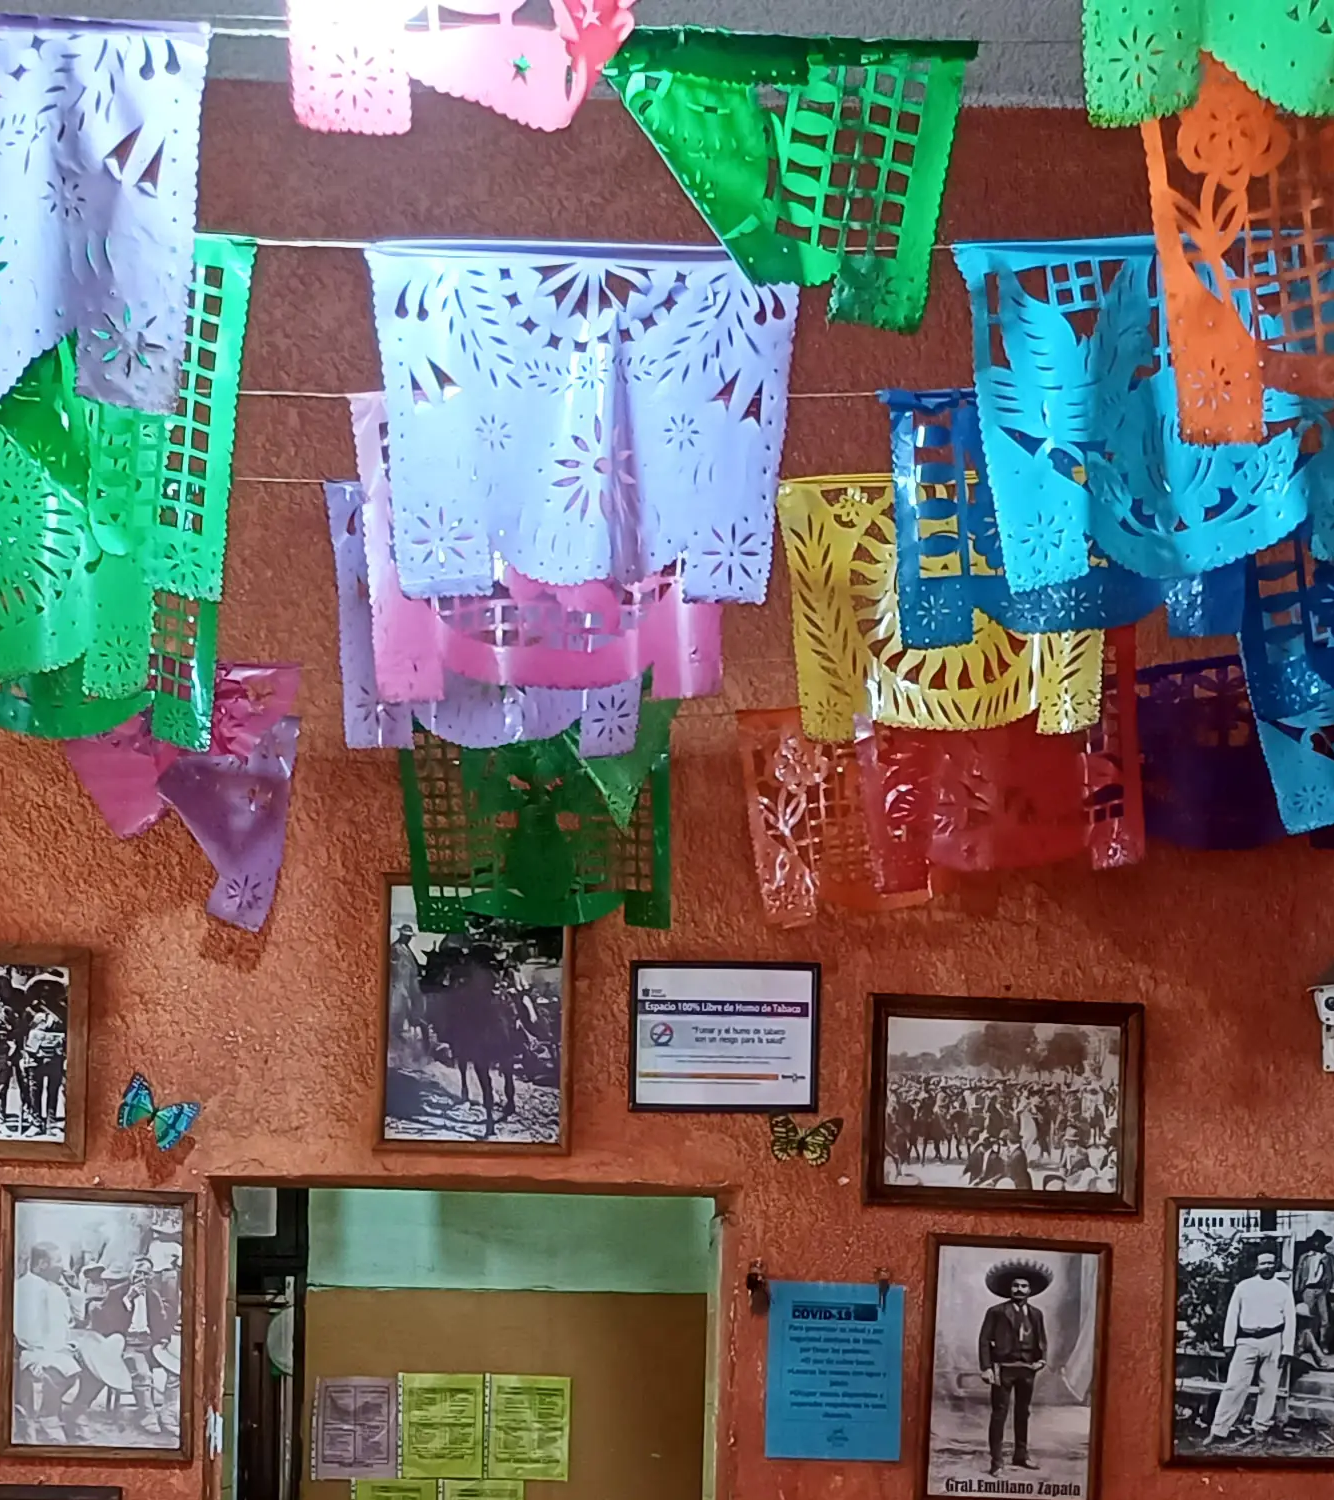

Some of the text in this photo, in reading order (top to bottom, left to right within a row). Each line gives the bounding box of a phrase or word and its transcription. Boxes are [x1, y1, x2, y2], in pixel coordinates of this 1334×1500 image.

[645, 1002, 801, 1013] Espacio 100% Libre de Humo de Tabaco
[1183, 1216, 1259, 1228] PANCHO VILLA
[792, 1309, 852, 1321] COVID-19
[1037, 1481, 1081, 1497] Zapata
